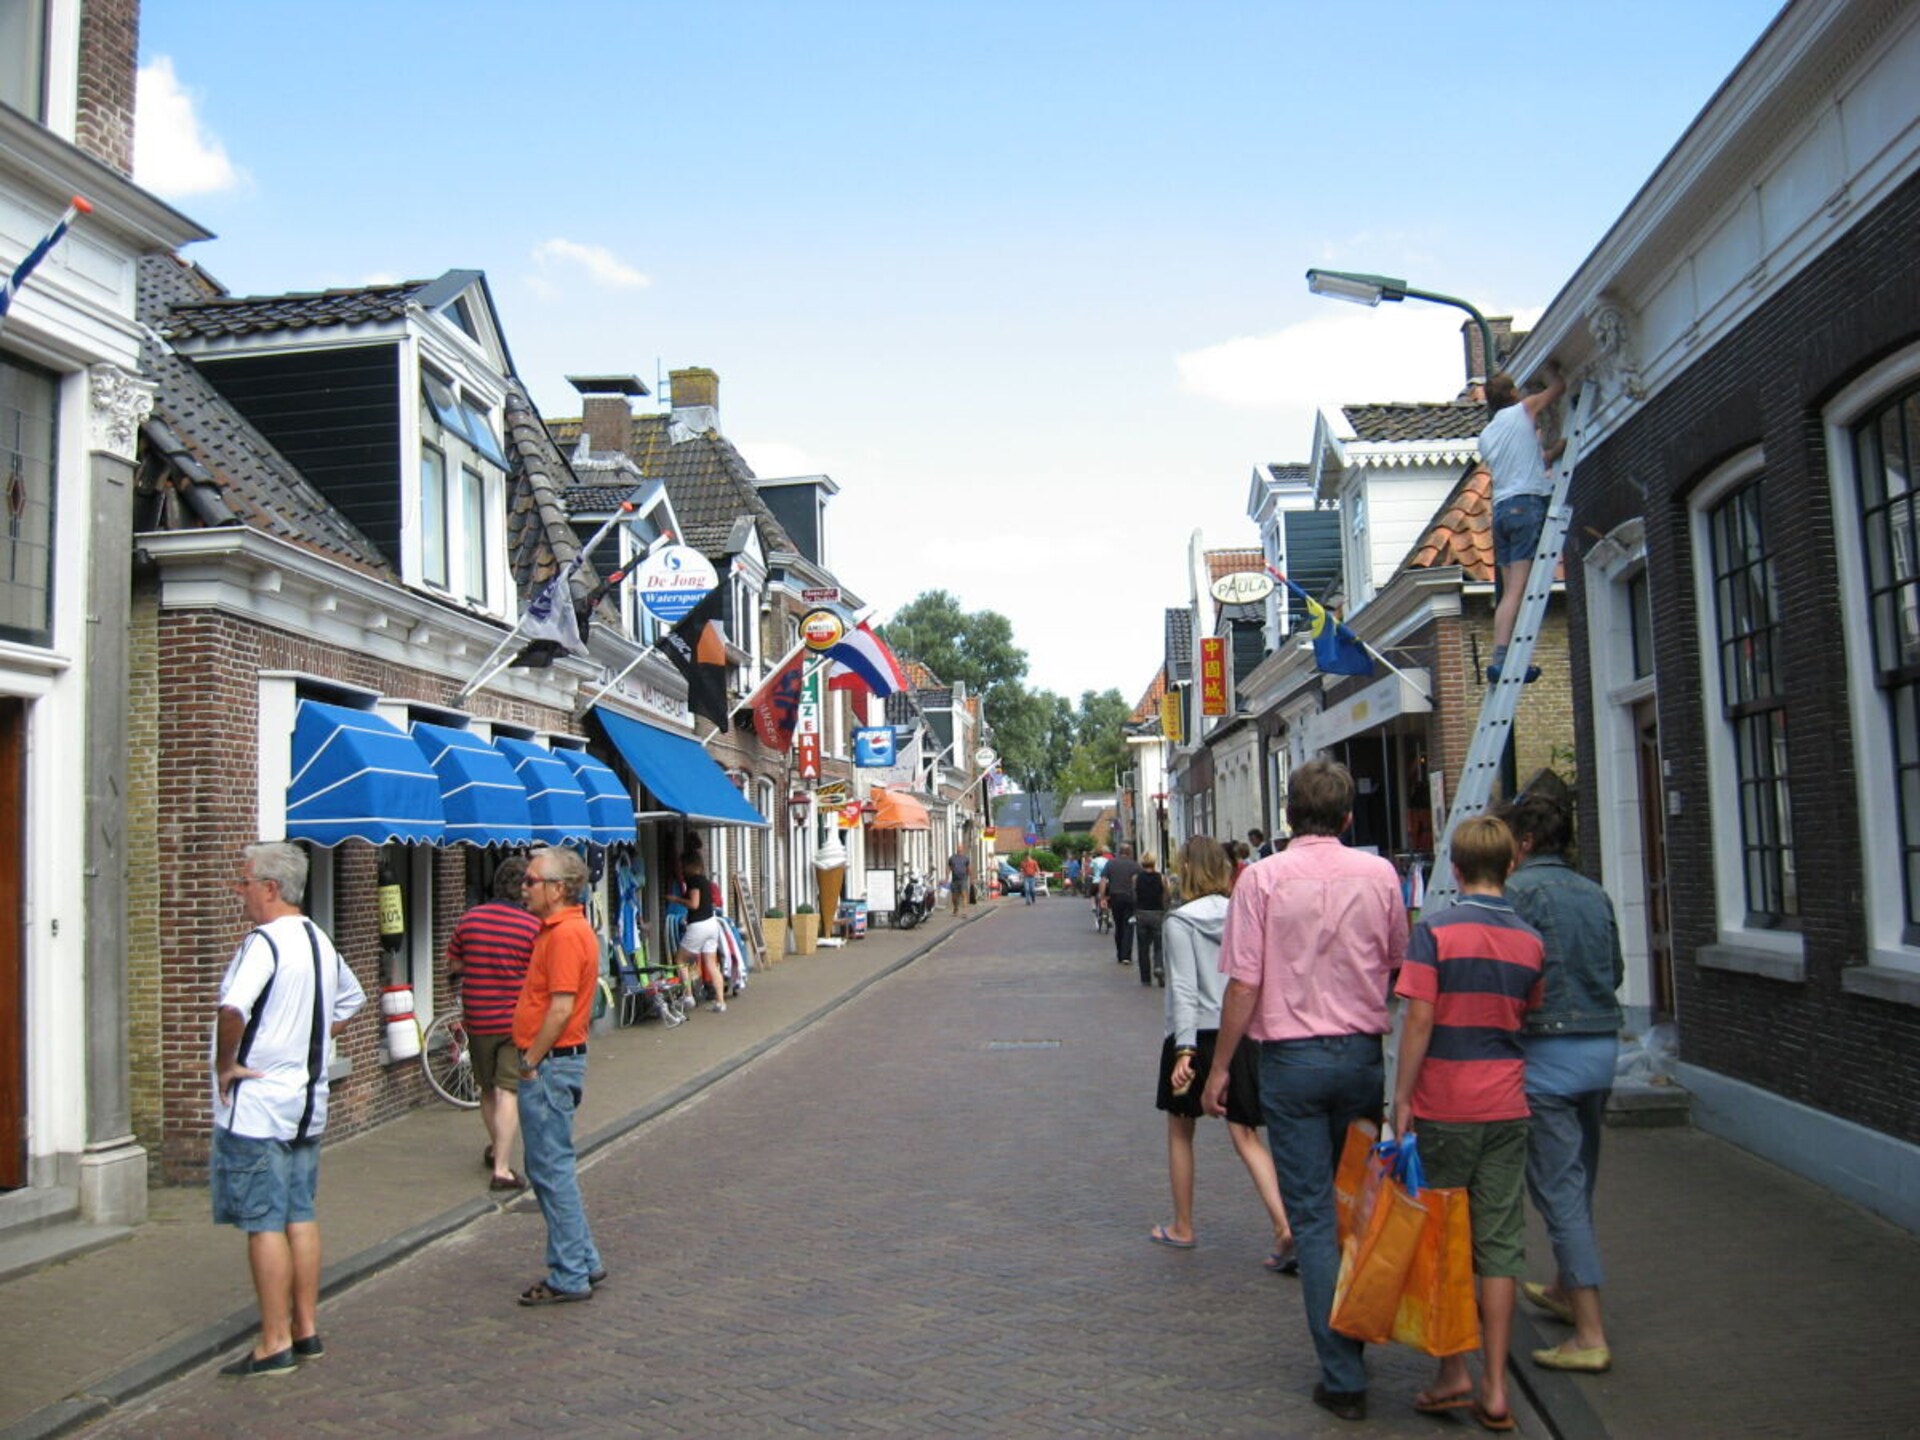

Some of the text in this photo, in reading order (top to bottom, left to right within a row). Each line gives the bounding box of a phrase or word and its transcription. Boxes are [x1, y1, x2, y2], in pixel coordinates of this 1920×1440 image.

[647, 574, 706, 589] De Jong
[1218, 575, 1268, 602] PAULA
[857, 731, 892, 741] PEPSI
